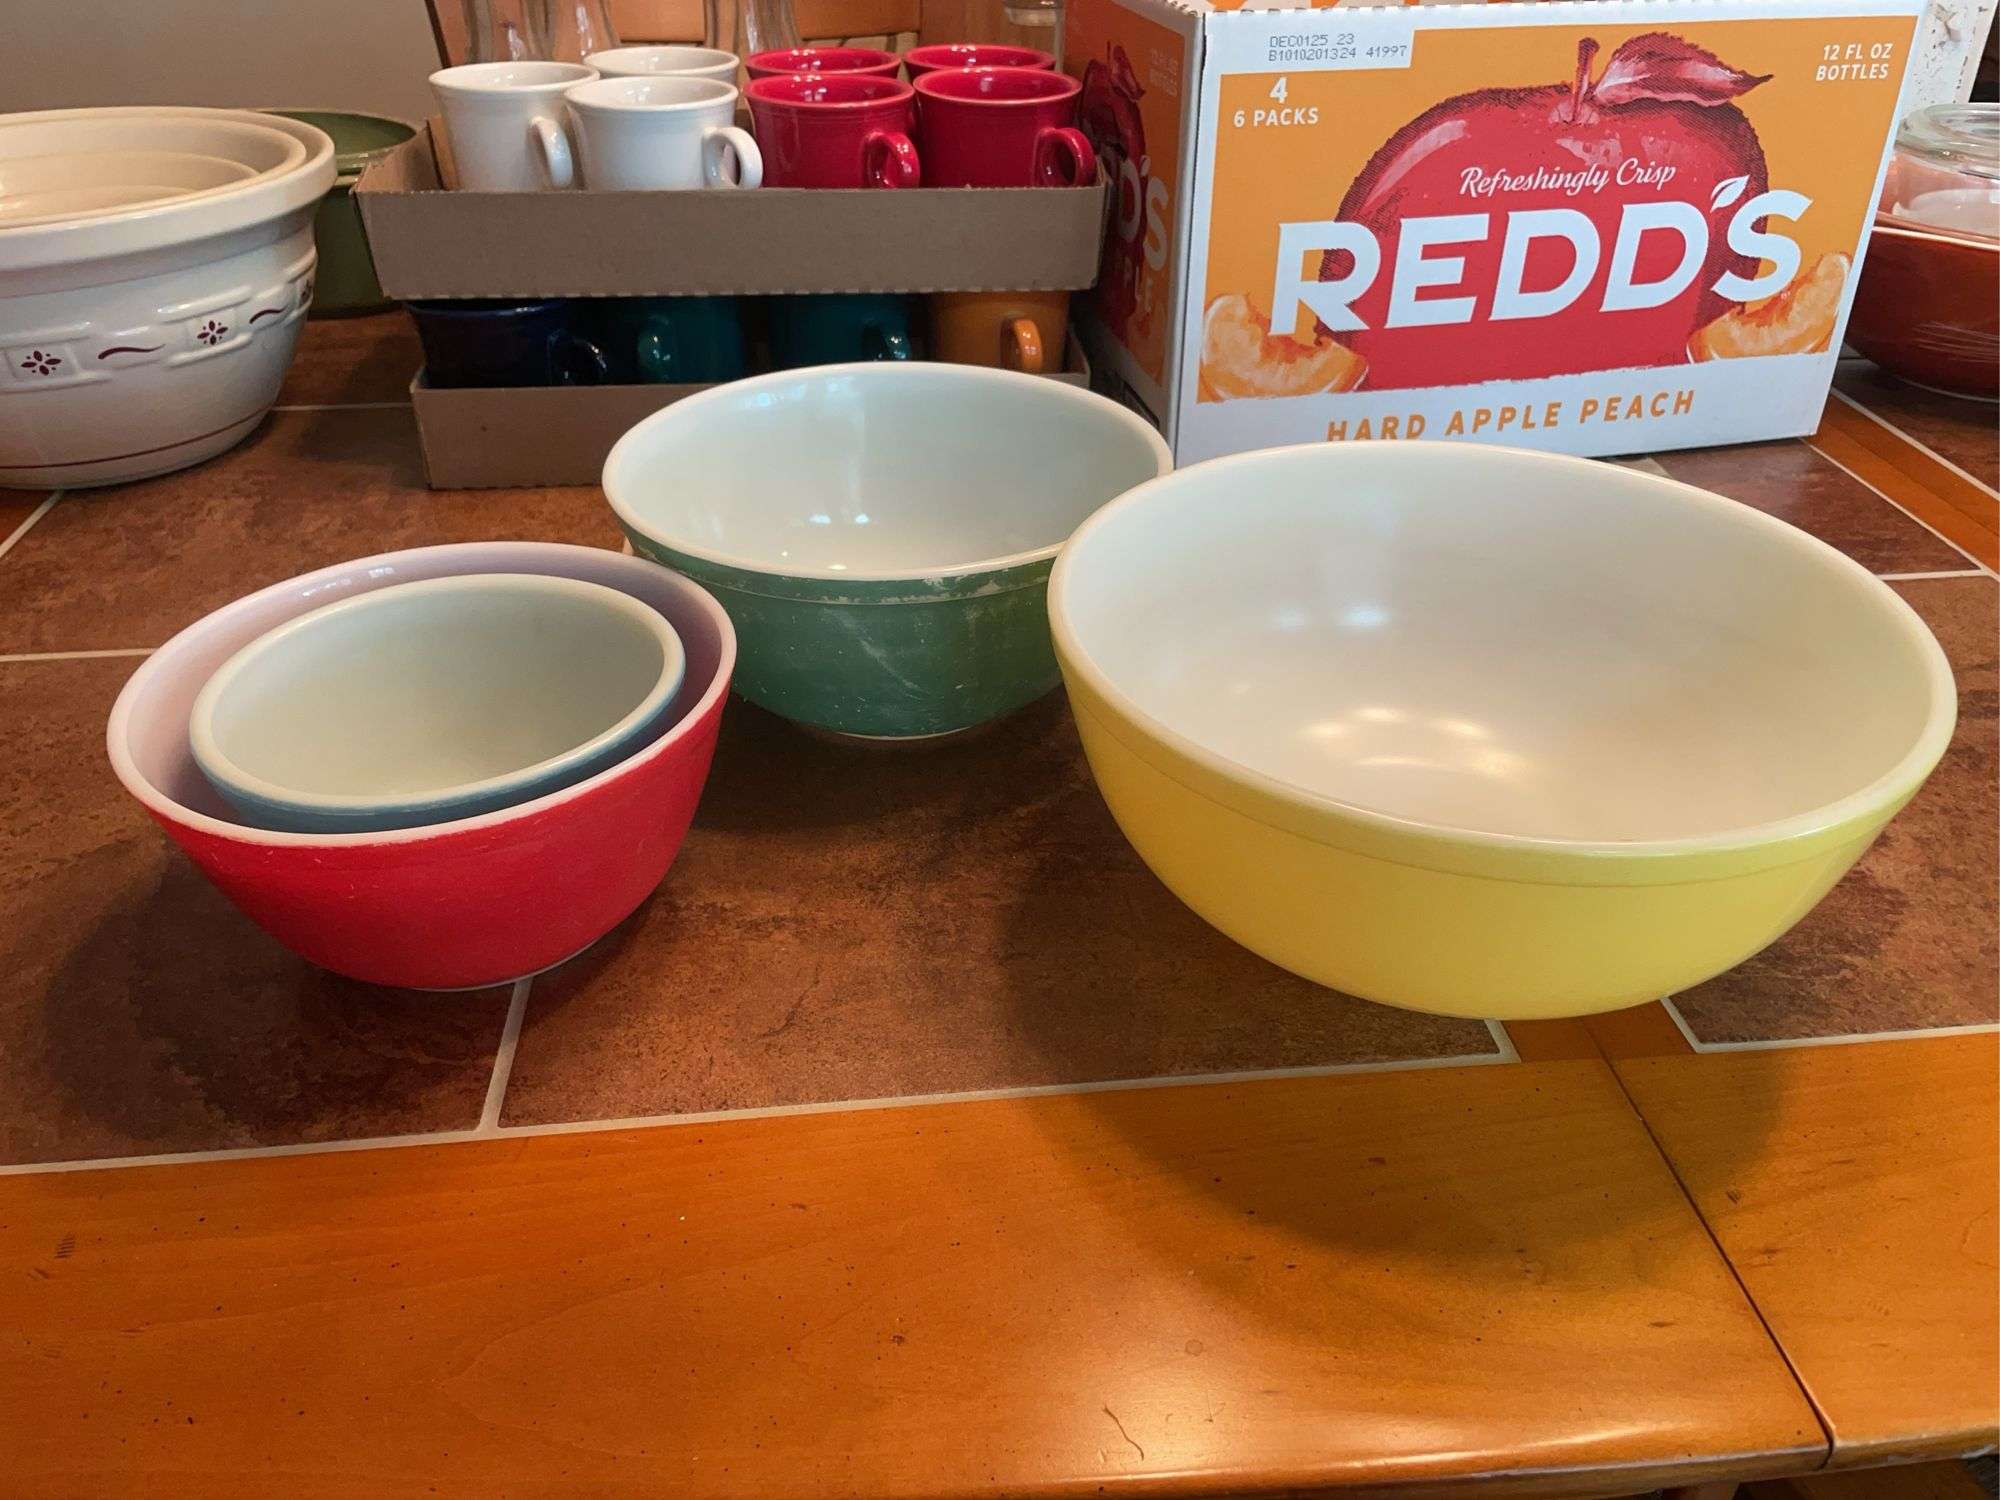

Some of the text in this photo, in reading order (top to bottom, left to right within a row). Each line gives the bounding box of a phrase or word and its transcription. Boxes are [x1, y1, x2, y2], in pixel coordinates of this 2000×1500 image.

[1270, 34, 1355, 48] DEC0125 23
[1366, 46, 1407, 58] 41997
[1823, 43, 1894, 61] 12 FL OZ
[1816, 64, 1889, 82] BOTTLES
[1269, 77, 1288, 103] 4
[1233, 108, 1319, 128] 6 PACKS
[1459, 157, 1677, 198] Refreshingly Crisp
[1267, 174, 1814, 336] REDD'S
[1326, 389, 1695, 442] HARD APPLE PEACH
